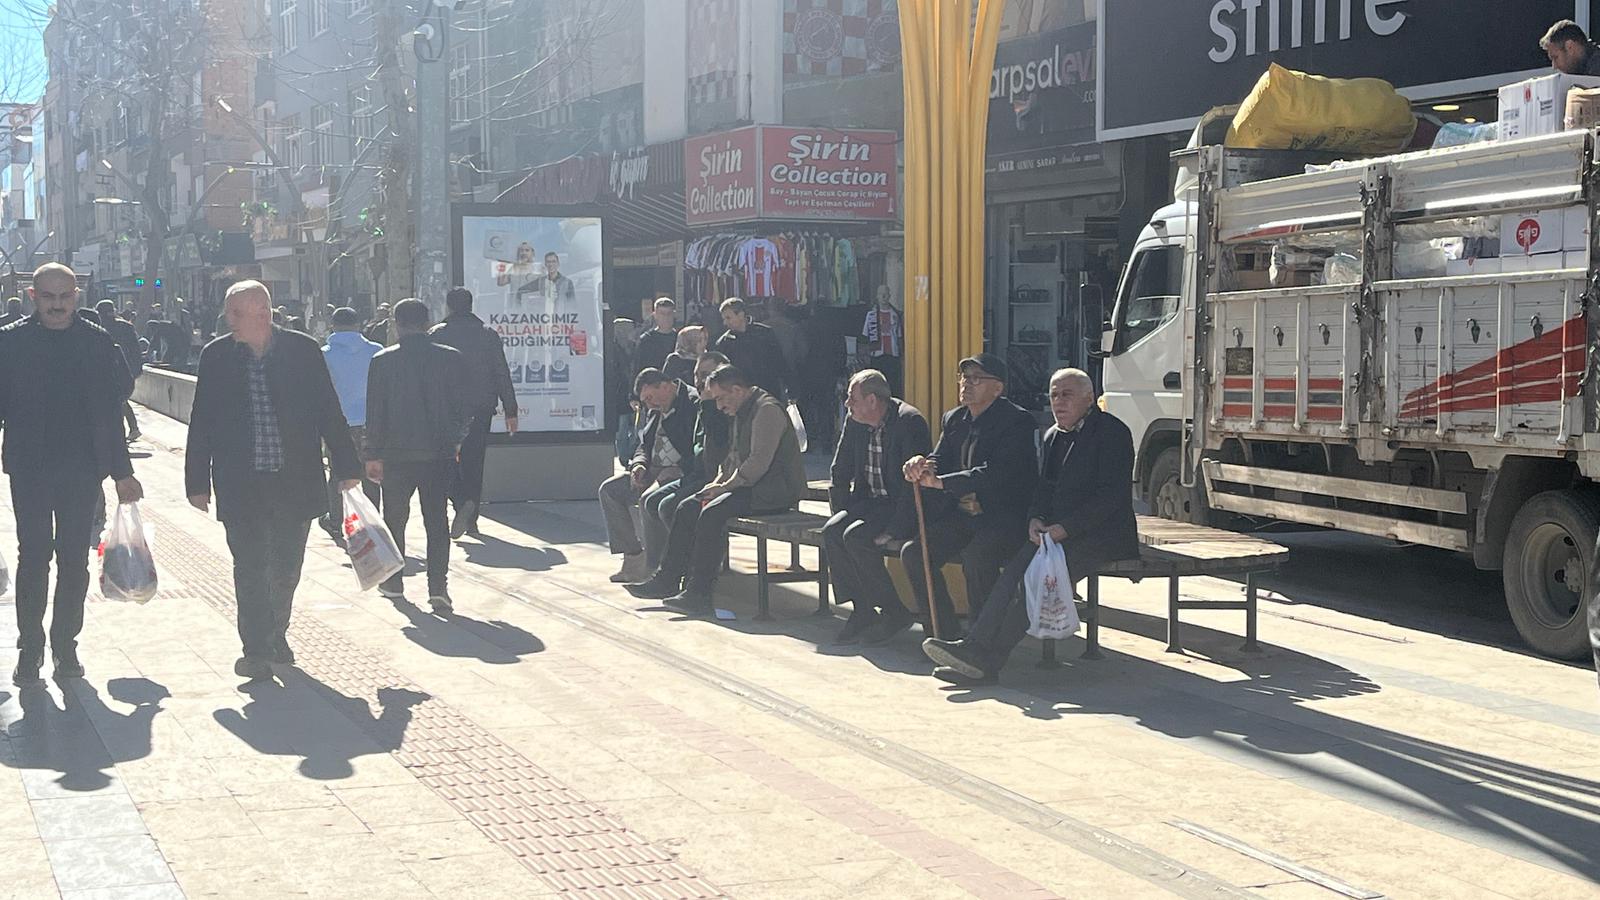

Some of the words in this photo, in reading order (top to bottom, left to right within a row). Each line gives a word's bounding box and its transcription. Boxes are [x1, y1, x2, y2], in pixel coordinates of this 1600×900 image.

[700, 140, 742, 187] Şirin
[788, 134, 870, 166] Şirin
[769, 164, 888, 186] Collection
[690, 179, 754, 215] Collection
[490, 313, 579, 324] KAZANCIMIZ
[497, 325, 542, 336] ALLAH
